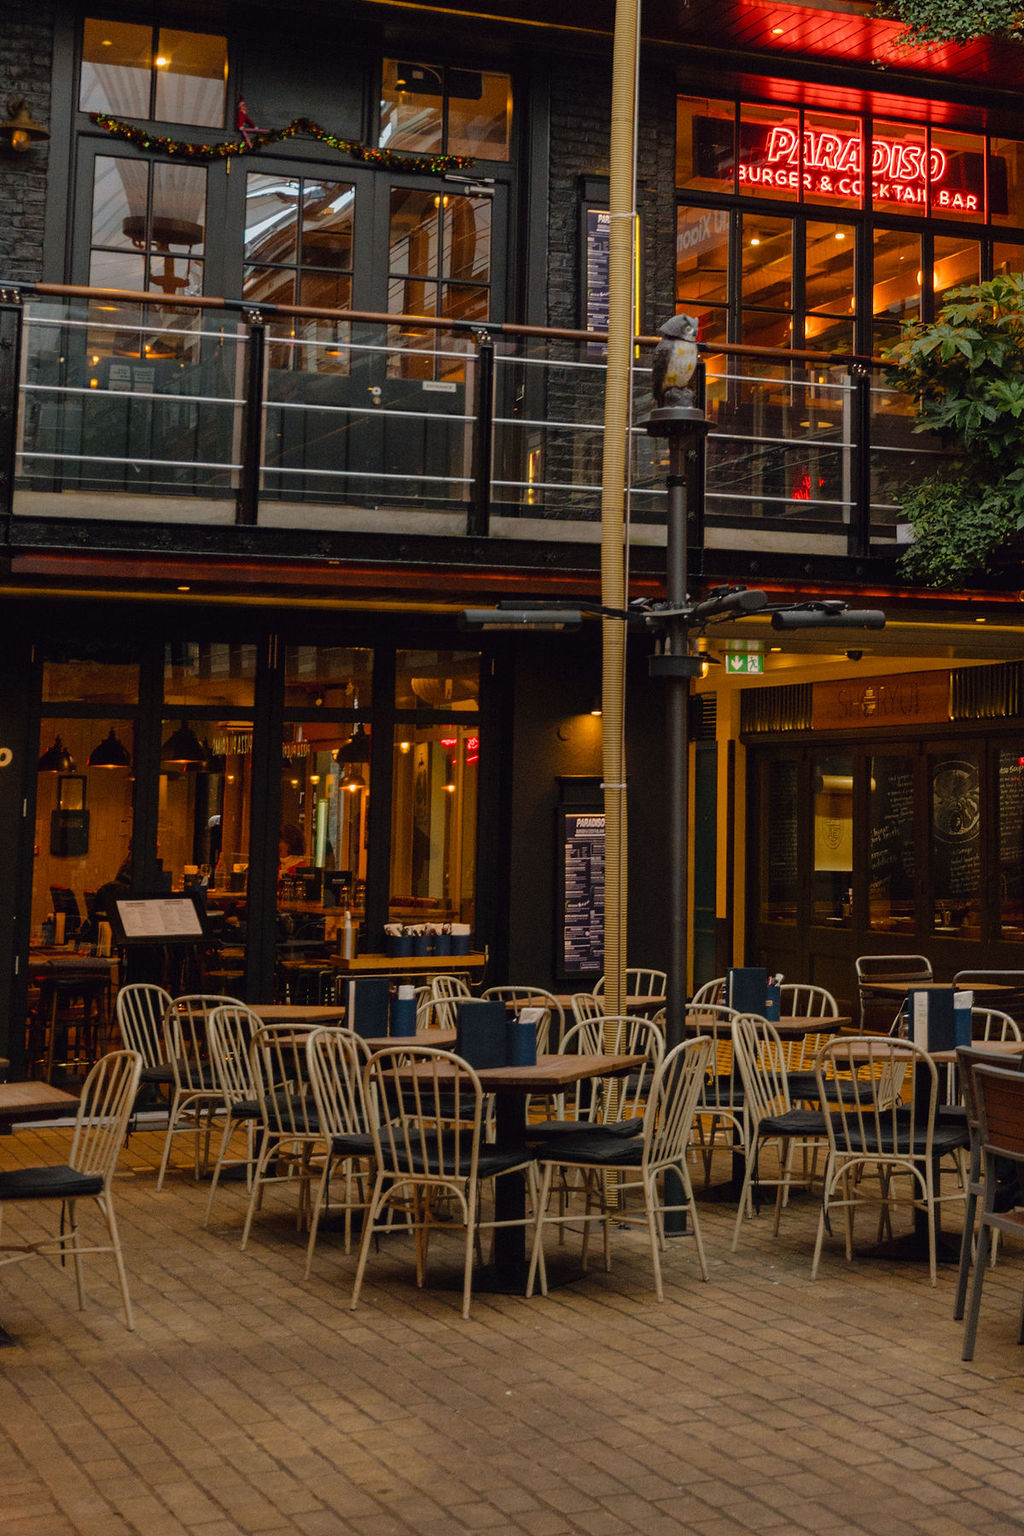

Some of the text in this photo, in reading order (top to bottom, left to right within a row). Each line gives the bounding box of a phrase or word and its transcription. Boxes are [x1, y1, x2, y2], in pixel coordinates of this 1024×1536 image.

[767, 127, 946, 183] PARADISO
[739, 164, 812, 190] BURGER
[820, 176, 833, 191] &
[939, 190, 977, 210] BAR
